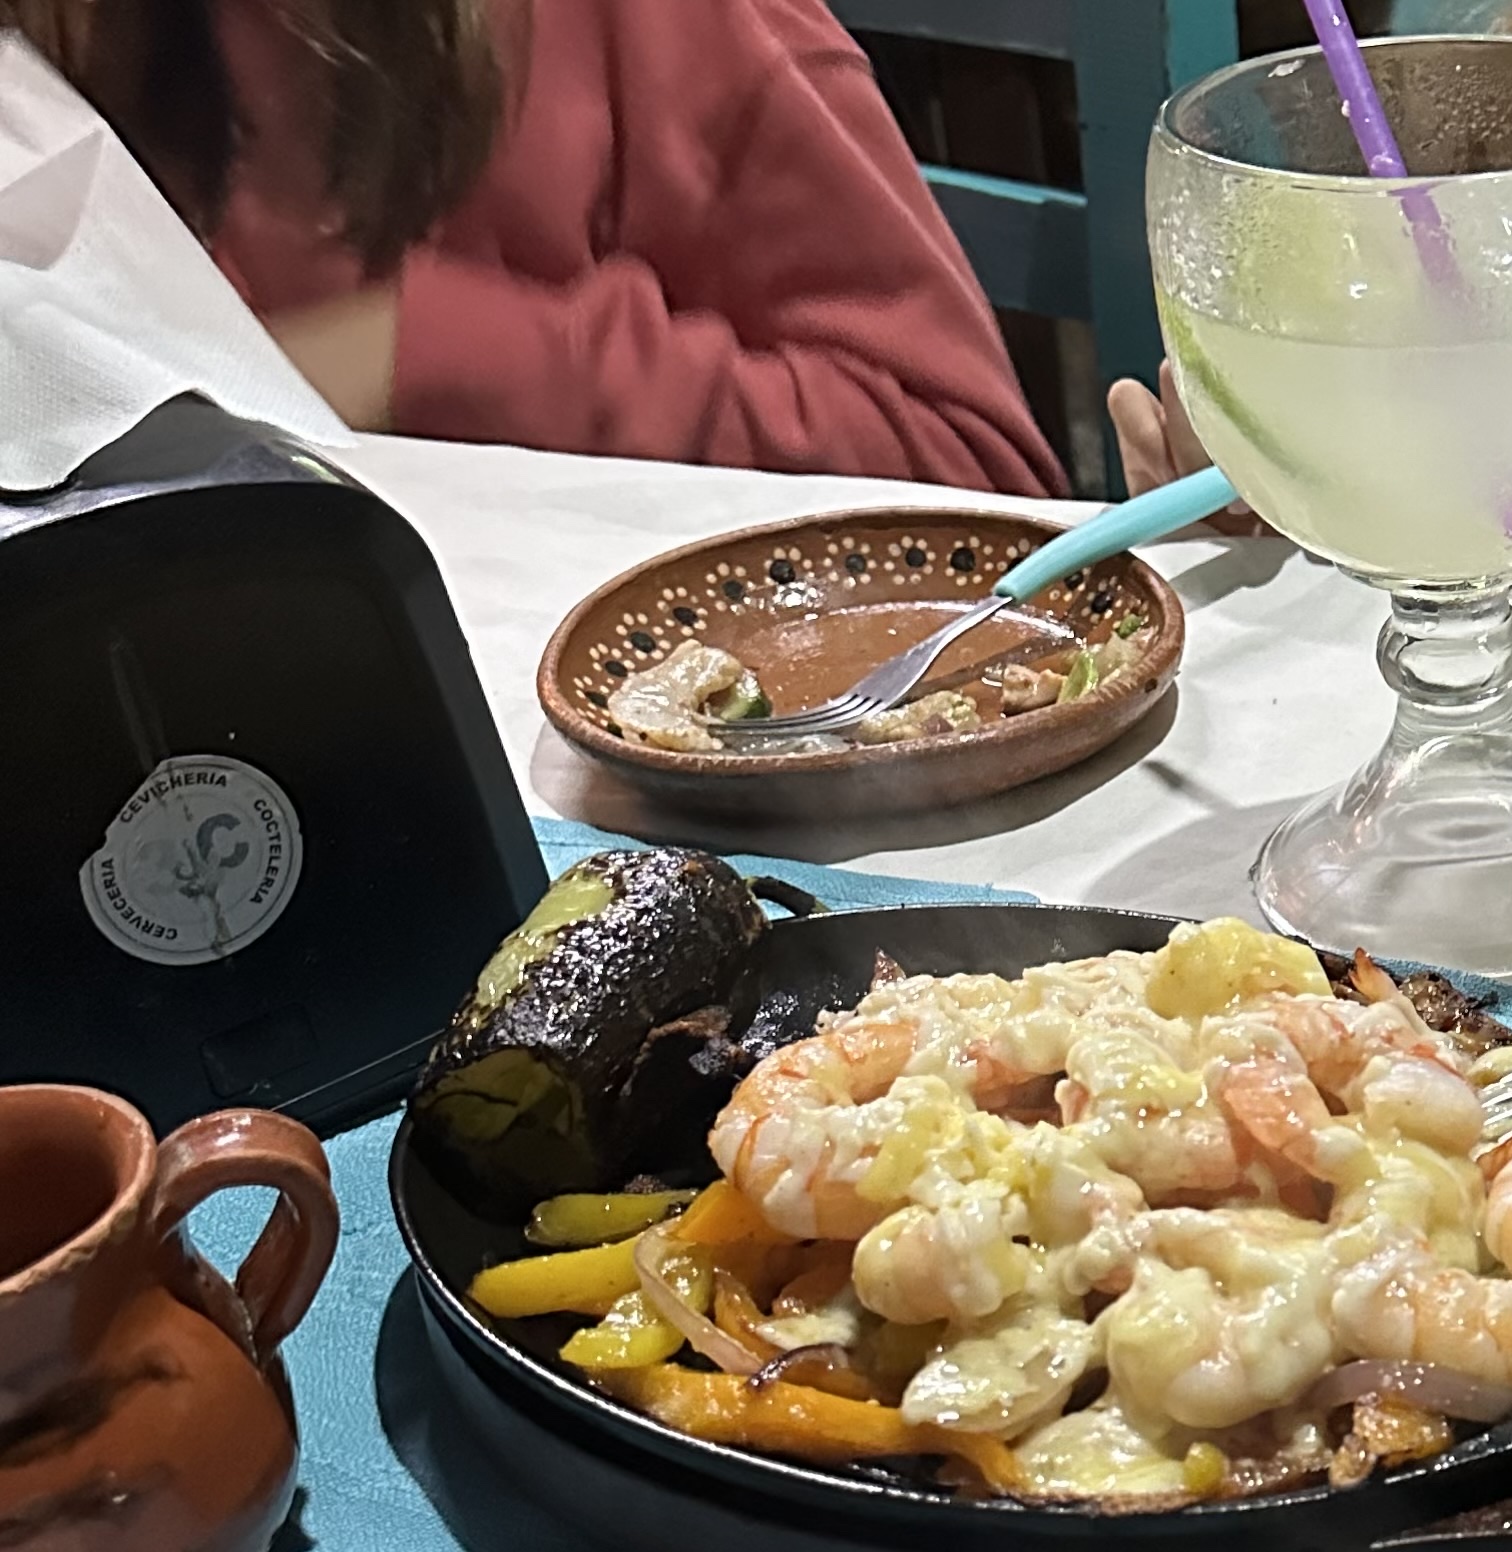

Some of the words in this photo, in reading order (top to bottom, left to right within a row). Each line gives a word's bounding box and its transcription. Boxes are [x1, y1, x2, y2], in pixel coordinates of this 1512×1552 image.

[119, 771, 227, 824] CEVICHERIA
[250, 798, 283, 905] COCTELERIA
[101, 857, 178, 941] CERVECERIA
